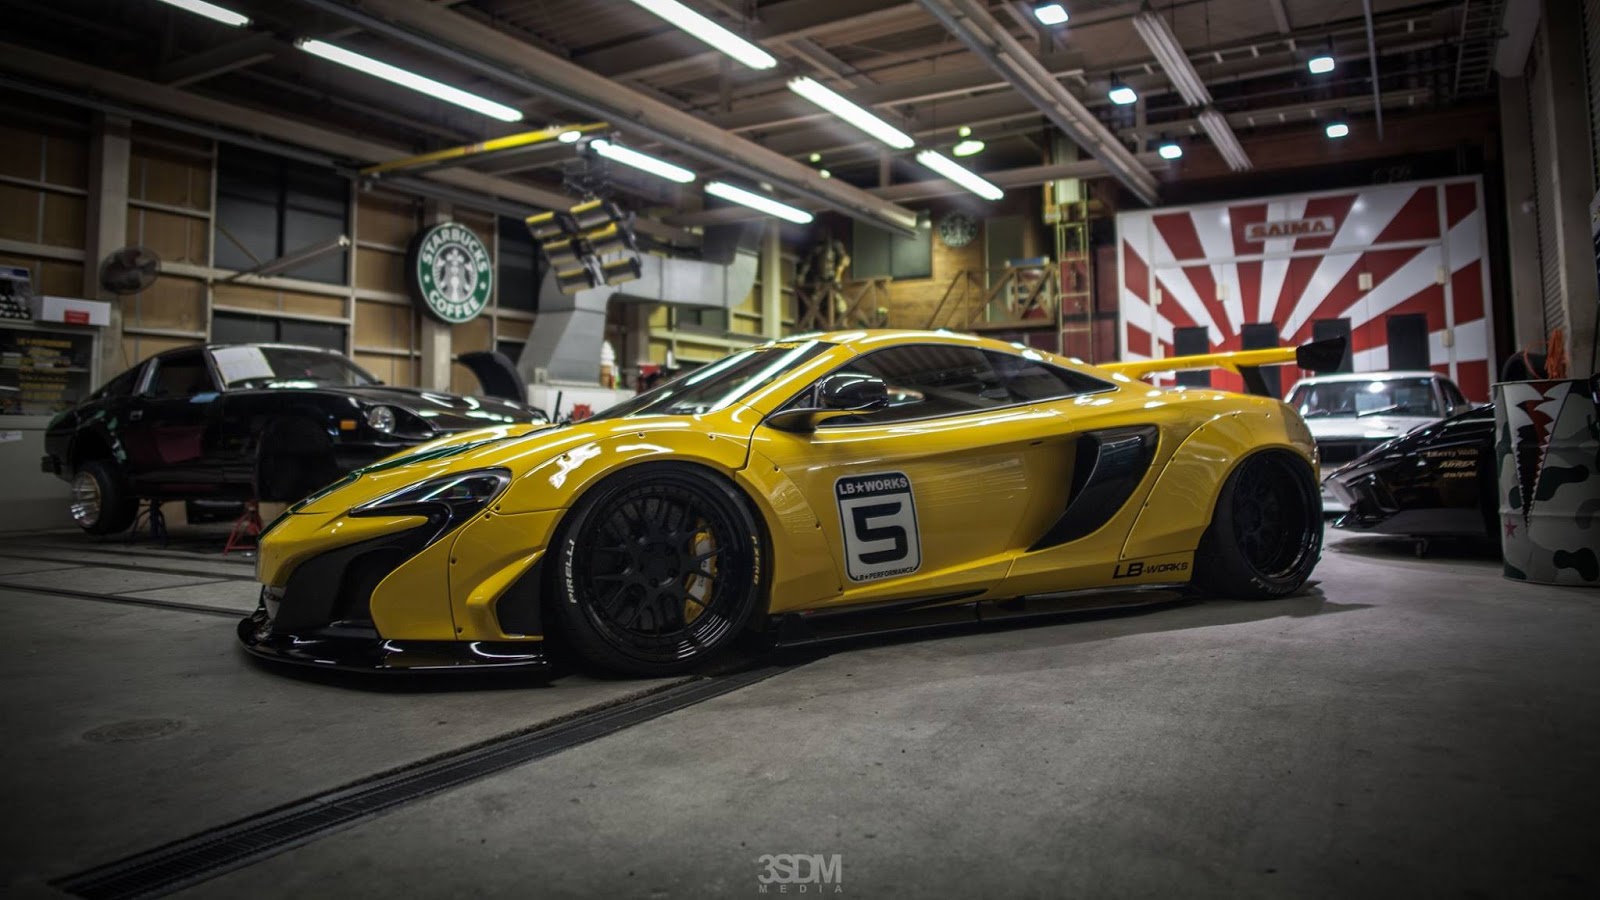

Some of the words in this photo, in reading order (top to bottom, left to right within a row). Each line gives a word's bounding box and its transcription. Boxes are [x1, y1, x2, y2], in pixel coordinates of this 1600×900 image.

[421, 227, 489, 273] STARBUCKS
[1252, 220, 1326, 238] SAIMA
[429, 290, 480, 318] COFFEE
[851, 502, 908, 565] 5
[565, 538, 577, 604] PIRELLI
